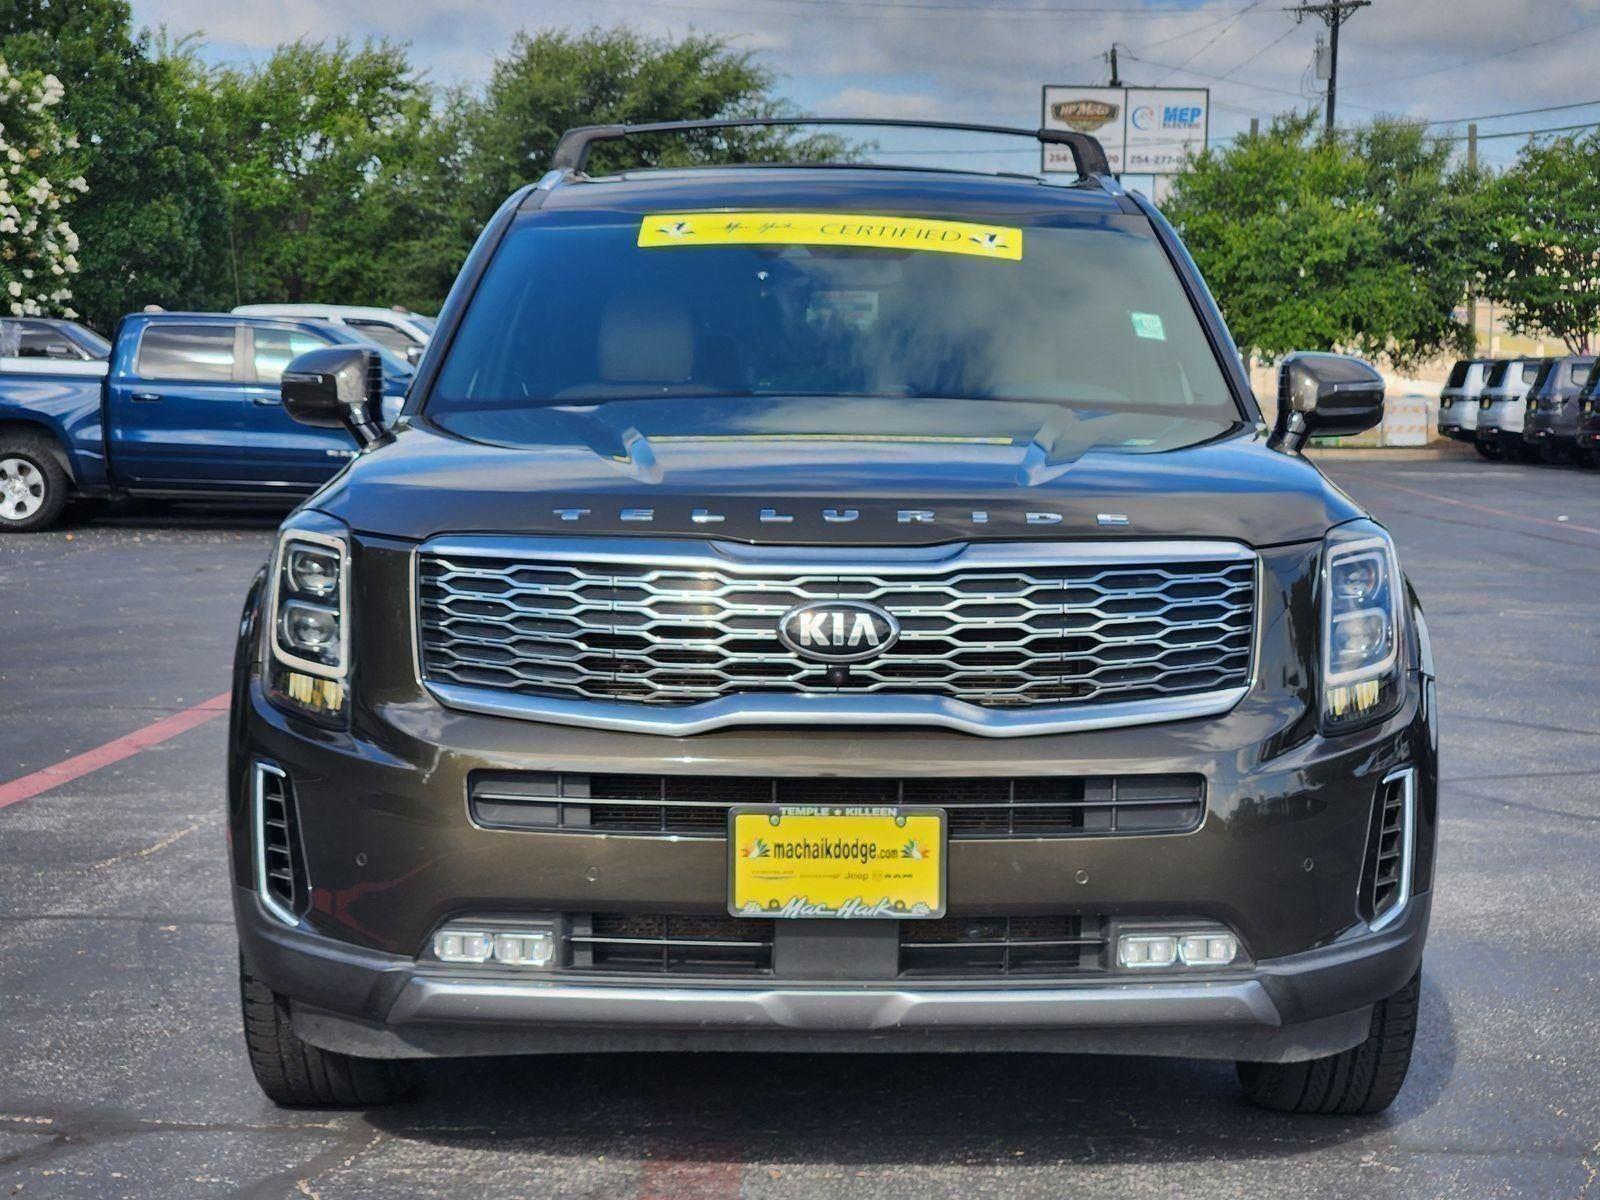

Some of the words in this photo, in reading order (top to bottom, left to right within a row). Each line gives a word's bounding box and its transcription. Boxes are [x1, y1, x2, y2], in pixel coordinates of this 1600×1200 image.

[1164, 106, 1202, 123] MEP
[820, 223, 961, 243] CERTIFIED
[552, 508, 1130, 525] TELLURIDE
[799, 612, 880, 647] KIA
[779, 806, 830, 817] TEMPLE
[845, 807, 898, 817] KILLEEN
[773, 837, 899, 864] machaikdodge.com
